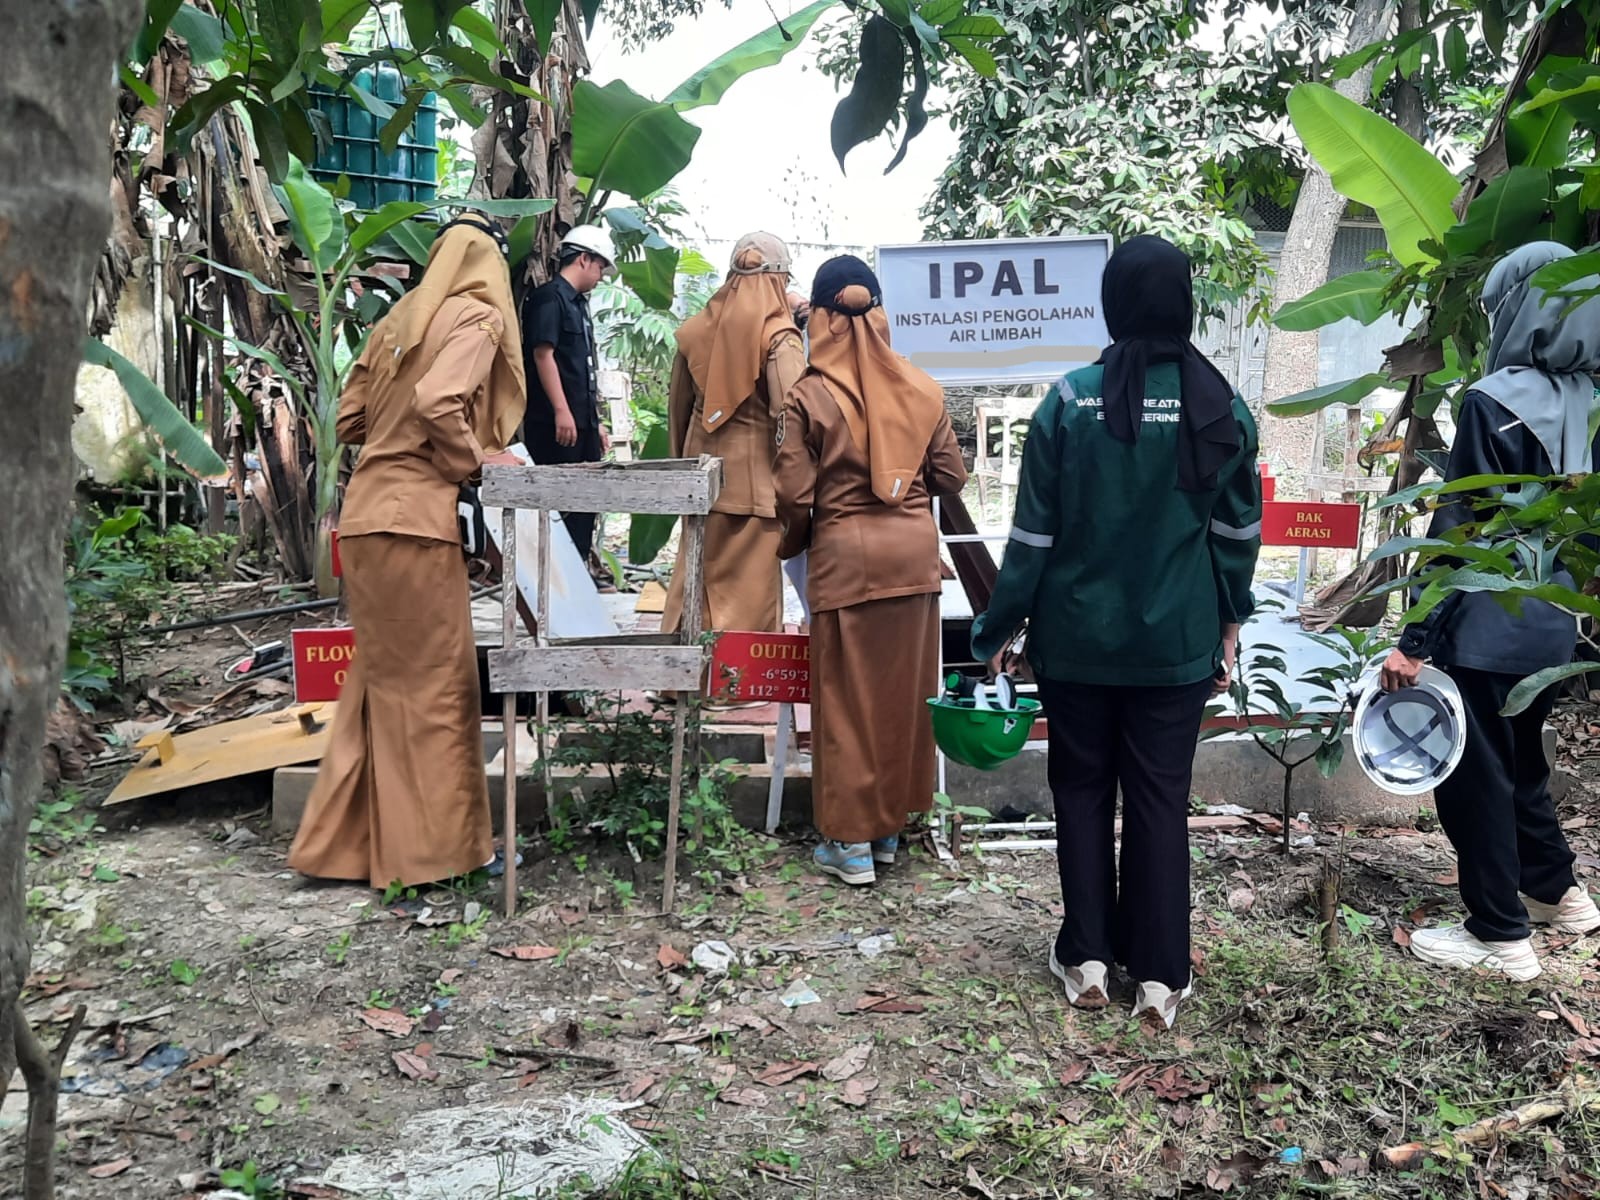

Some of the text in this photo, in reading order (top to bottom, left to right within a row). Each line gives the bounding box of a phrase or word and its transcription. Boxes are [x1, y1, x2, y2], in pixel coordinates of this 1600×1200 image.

[929, 259, 1059, 299] IPAL
[896, 306, 1095, 327] INSTALASI PENGOLAHAN
[950, 326, 1042, 343] AIR LIMBAH
[1296, 512, 1322, 523] BAK
[1285, 527, 1331, 539] AERASI
[750, 643, 810, 660] OUTLE
